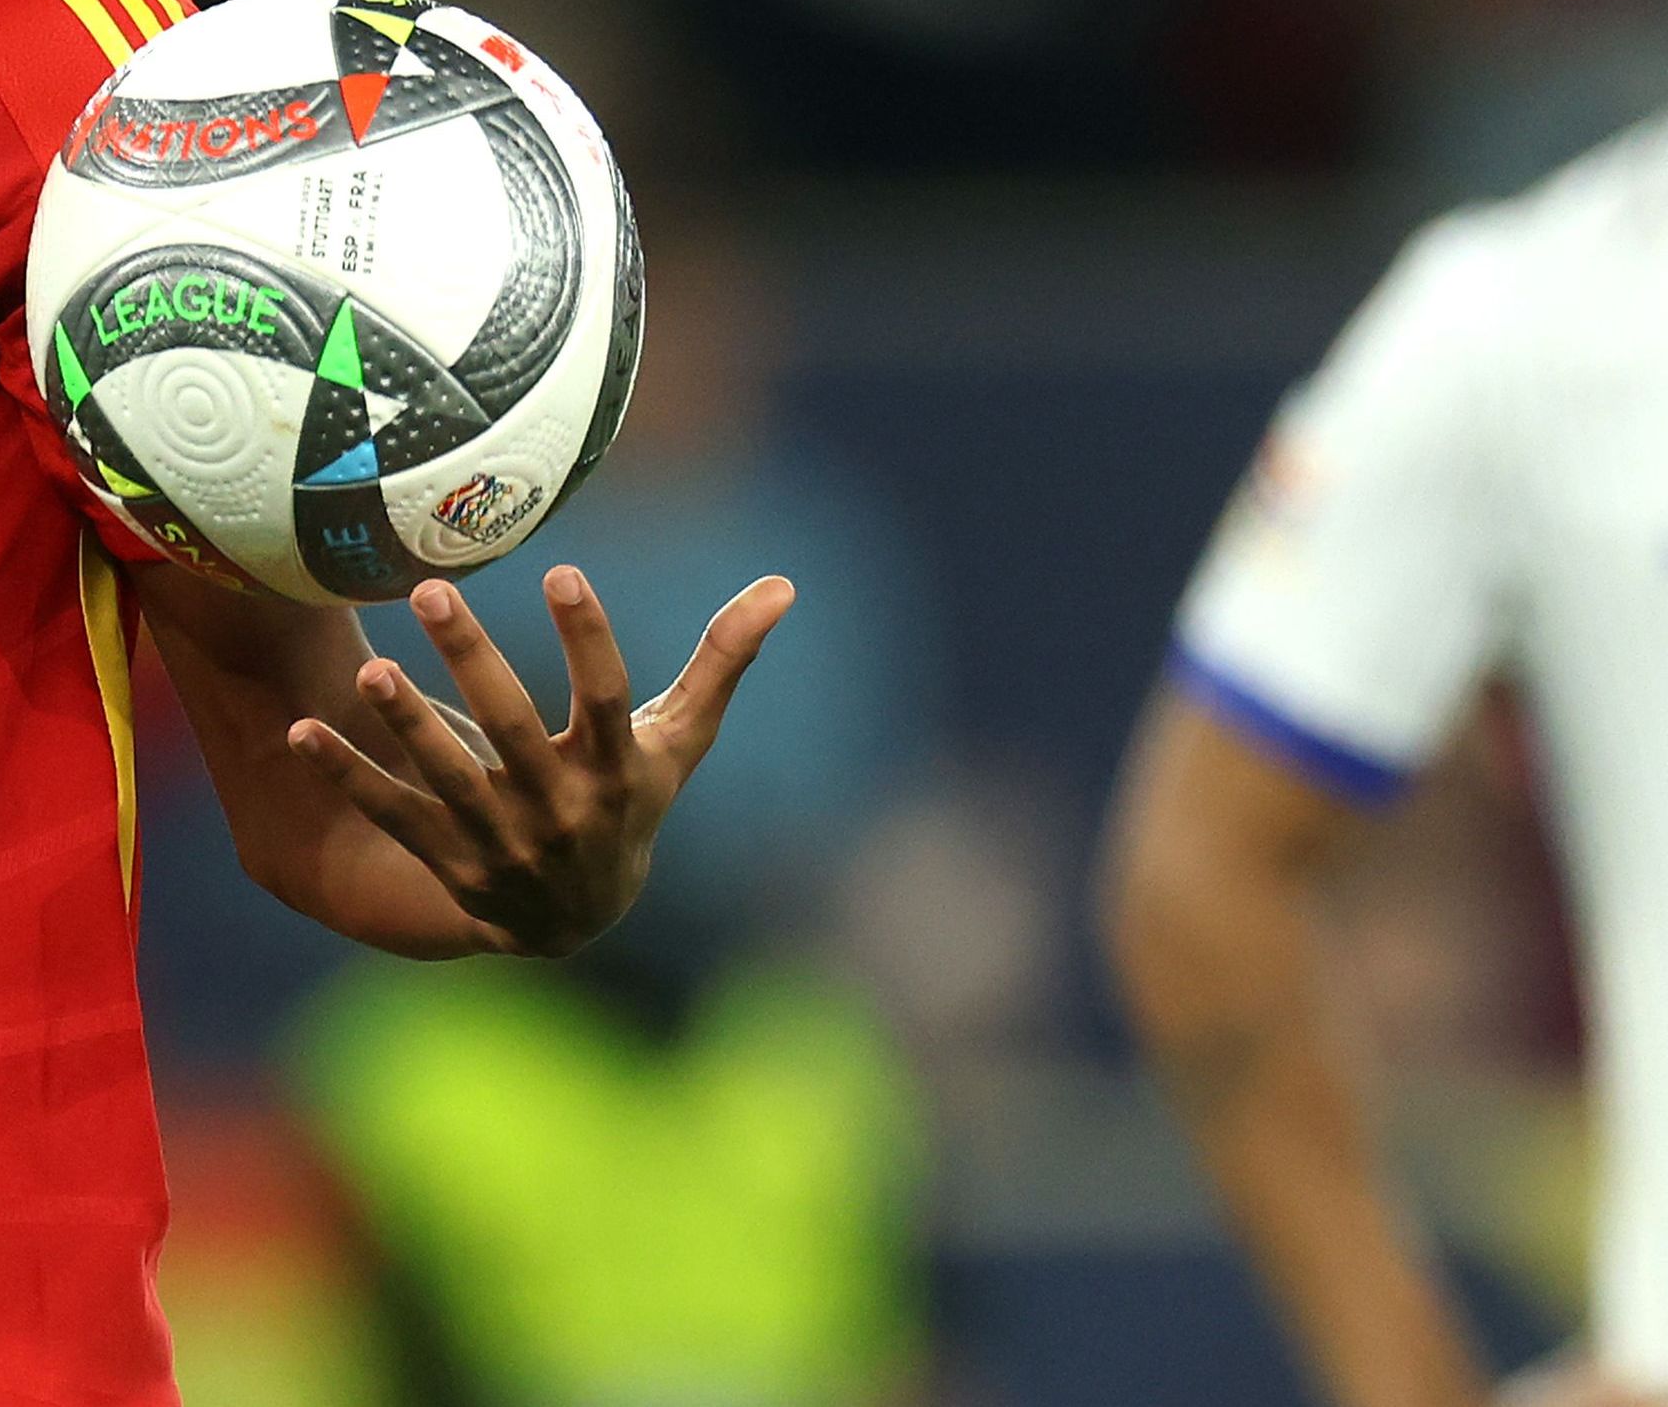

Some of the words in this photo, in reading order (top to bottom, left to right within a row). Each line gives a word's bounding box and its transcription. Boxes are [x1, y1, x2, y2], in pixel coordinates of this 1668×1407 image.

[92, 100, 318, 161] NATIONS
[311, 178, 333, 258] STUTTGART
[349, 171, 367, 209] FRA
[342, 235, 358, 272] ESP
[89, 273, 285, 347] LEAGUE
